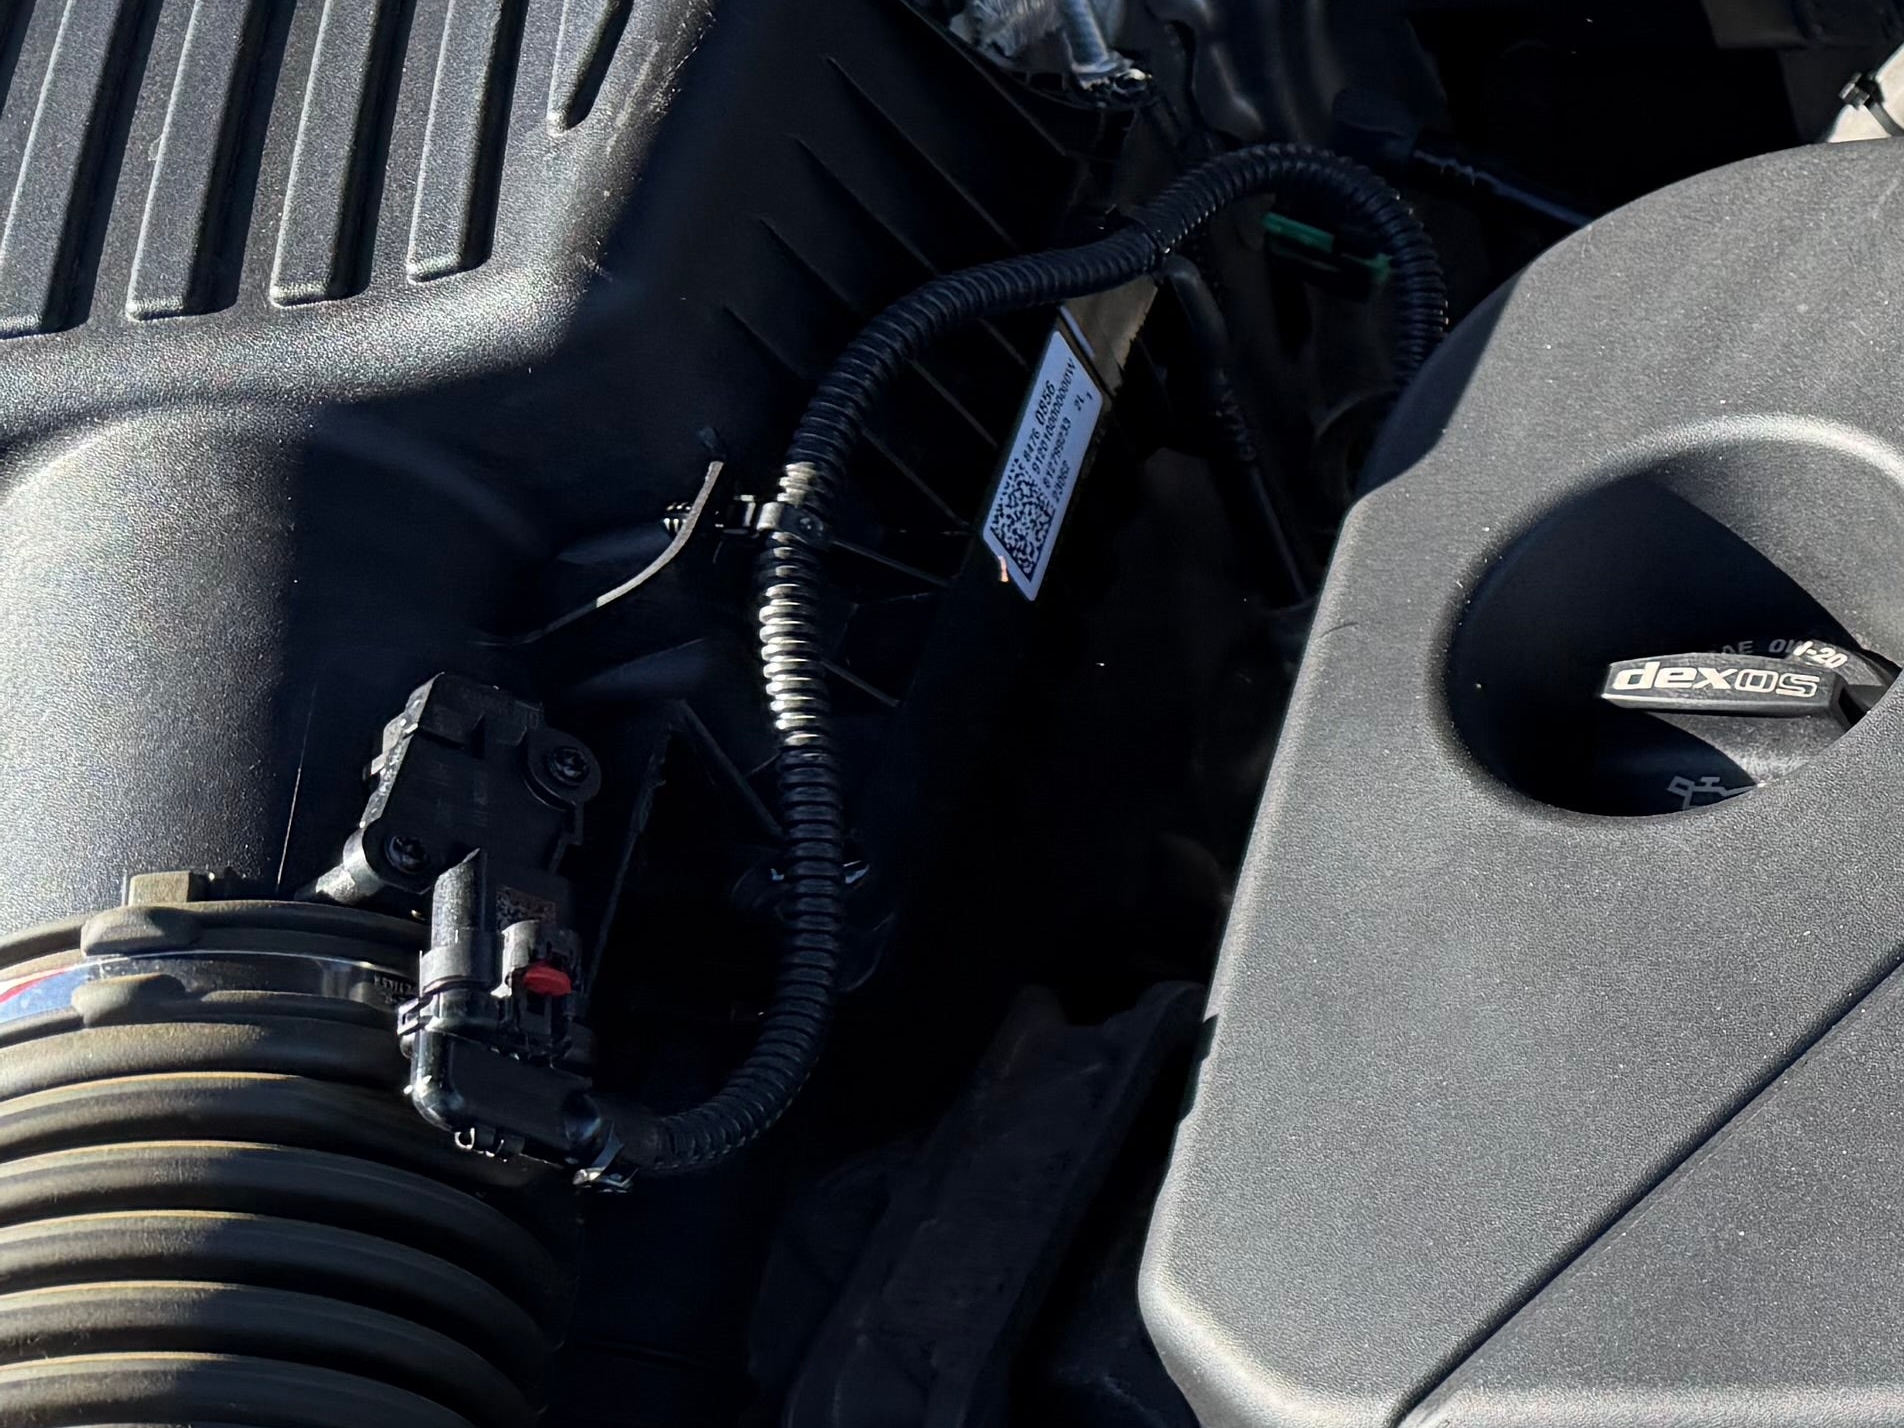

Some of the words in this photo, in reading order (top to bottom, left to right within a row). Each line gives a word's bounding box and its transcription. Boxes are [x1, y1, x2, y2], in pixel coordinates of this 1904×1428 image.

[1023, 427, 1041, 462] 8476
[1034, 379, 1055, 426] 0856
[1611, 660, 1821, 698] dexos
